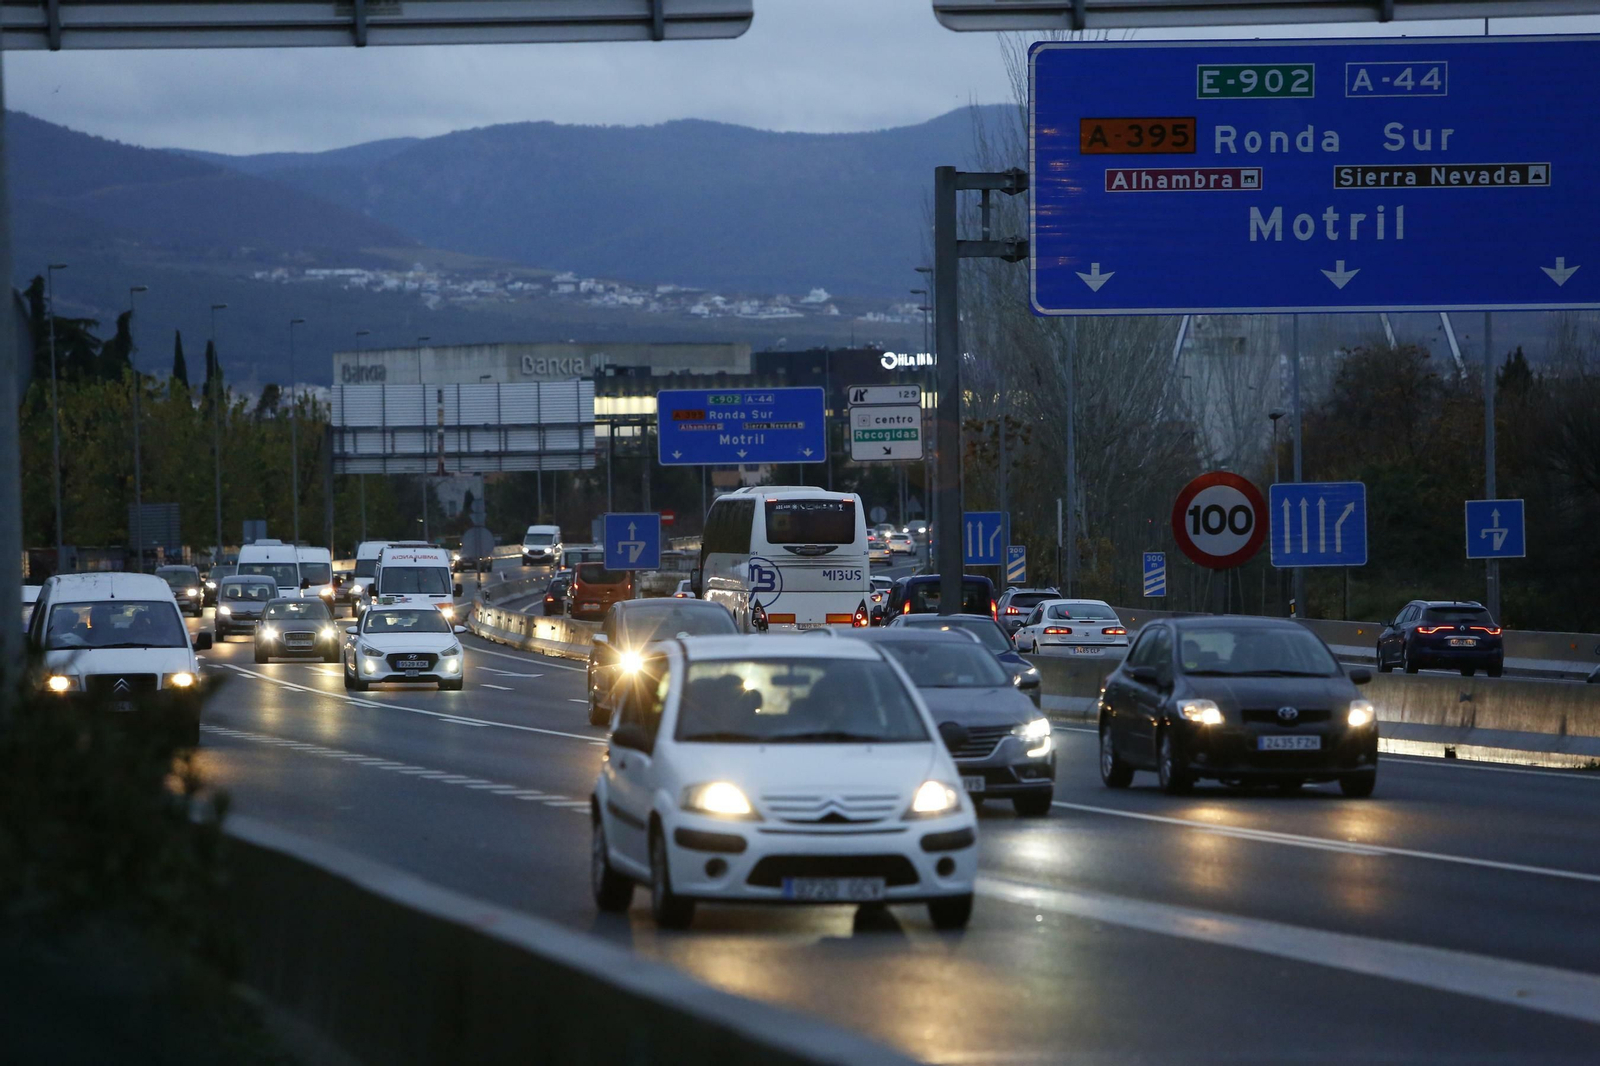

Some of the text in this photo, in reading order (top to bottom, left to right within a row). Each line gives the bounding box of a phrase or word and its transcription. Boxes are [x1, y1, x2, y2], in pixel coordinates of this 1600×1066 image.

[1202, 69, 1310, 94] E-902
[1352, 67, 1443, 92] A-44
[1087, 123, 1189, 148] A-395
[1214, 122, 1455, 154] Ronda Sur
[1112, 170, 1233, 189] Alhambra
[1339, 166, 1521, 187] Sierra Nevada
[1249, 206, 1405, 242] Motril
[522, 354, 584, 376] Bankia
[898, 390, 917, 398] 129
[709, 410, 773, 420] Ronda Sur
[875, 415, 913, 424] centro
[719, 434, 764, 445] Motril
[856, 430, 917, 440] Recogidas
[1188, 504, 1253, 536] 100
[1267, 737, 1318, 750] 2435 FZH
